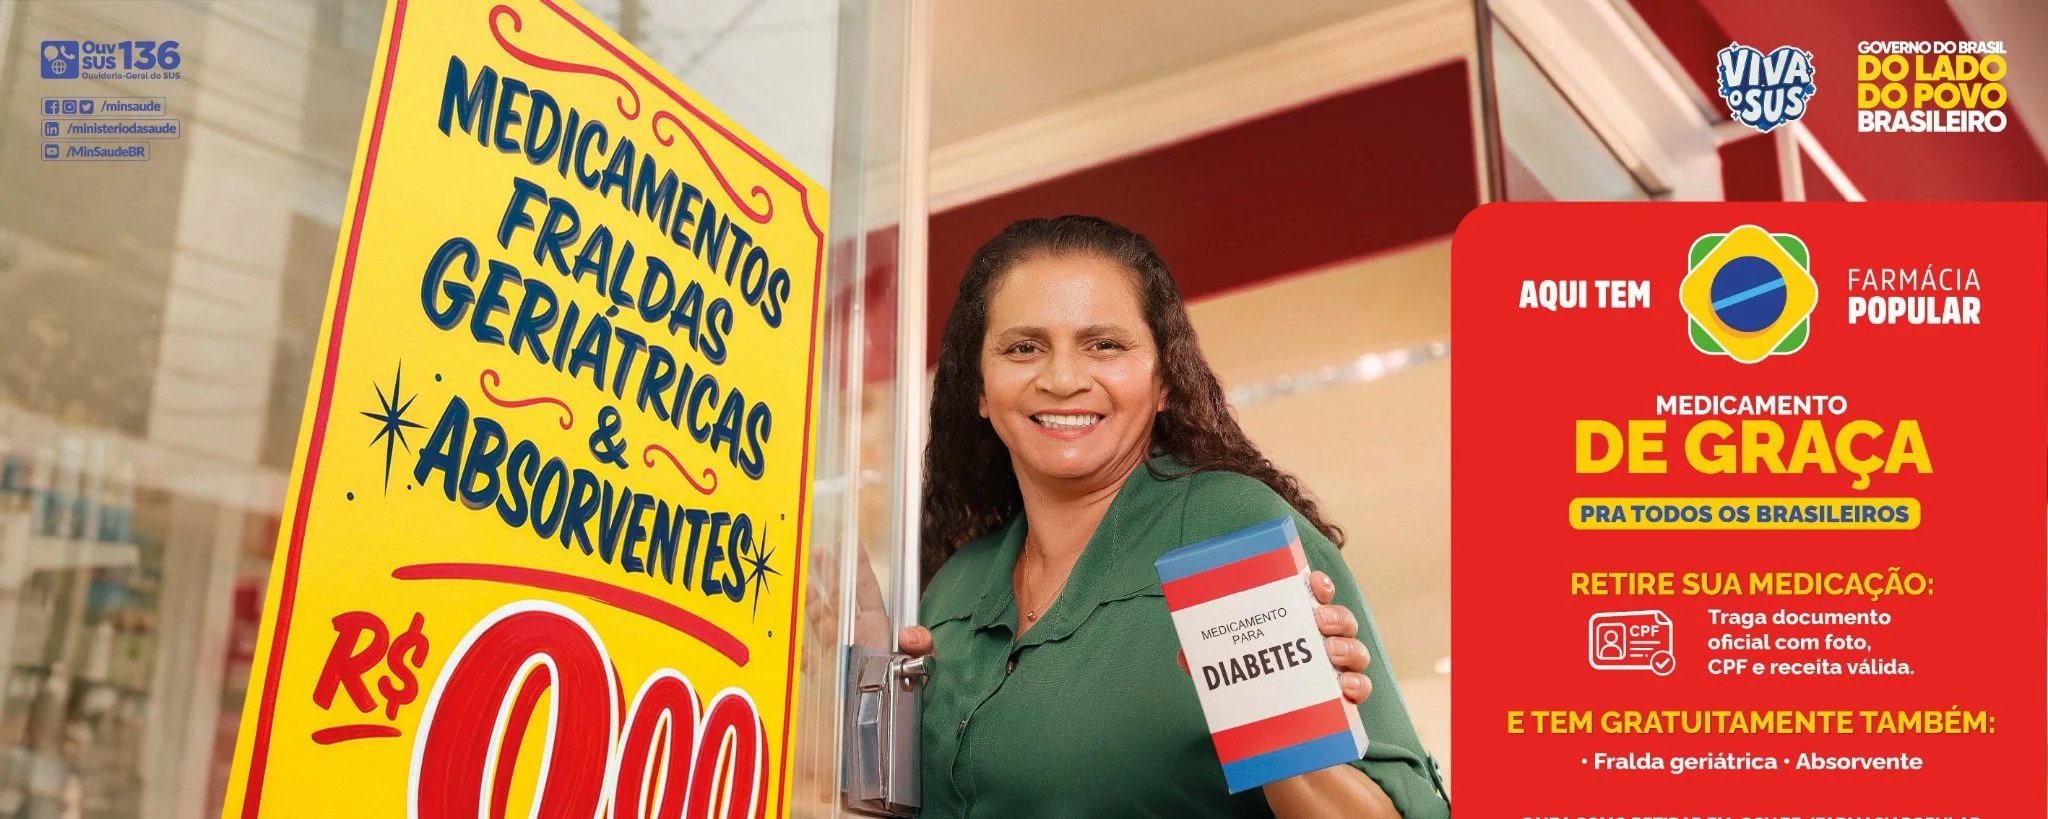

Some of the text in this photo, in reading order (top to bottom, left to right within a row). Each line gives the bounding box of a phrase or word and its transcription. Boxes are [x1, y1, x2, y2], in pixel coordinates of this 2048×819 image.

[438, 54, 790, 328] MEDICAMENTOS
[497, 177, 733, 366] FRALDAS
[420, 236, 772, 481] GERIÁTRICAS
[588, 404, 629, 470] &
[413, 395, 754, 602] ABSORVENTES
[312, 611, 429, 721] R$
[1201, 607, 1287, 640] MEDICAMENTO
[1202, 637, 1312, 691] DIABETES
[1232, 628, 1265, 645] PARA
